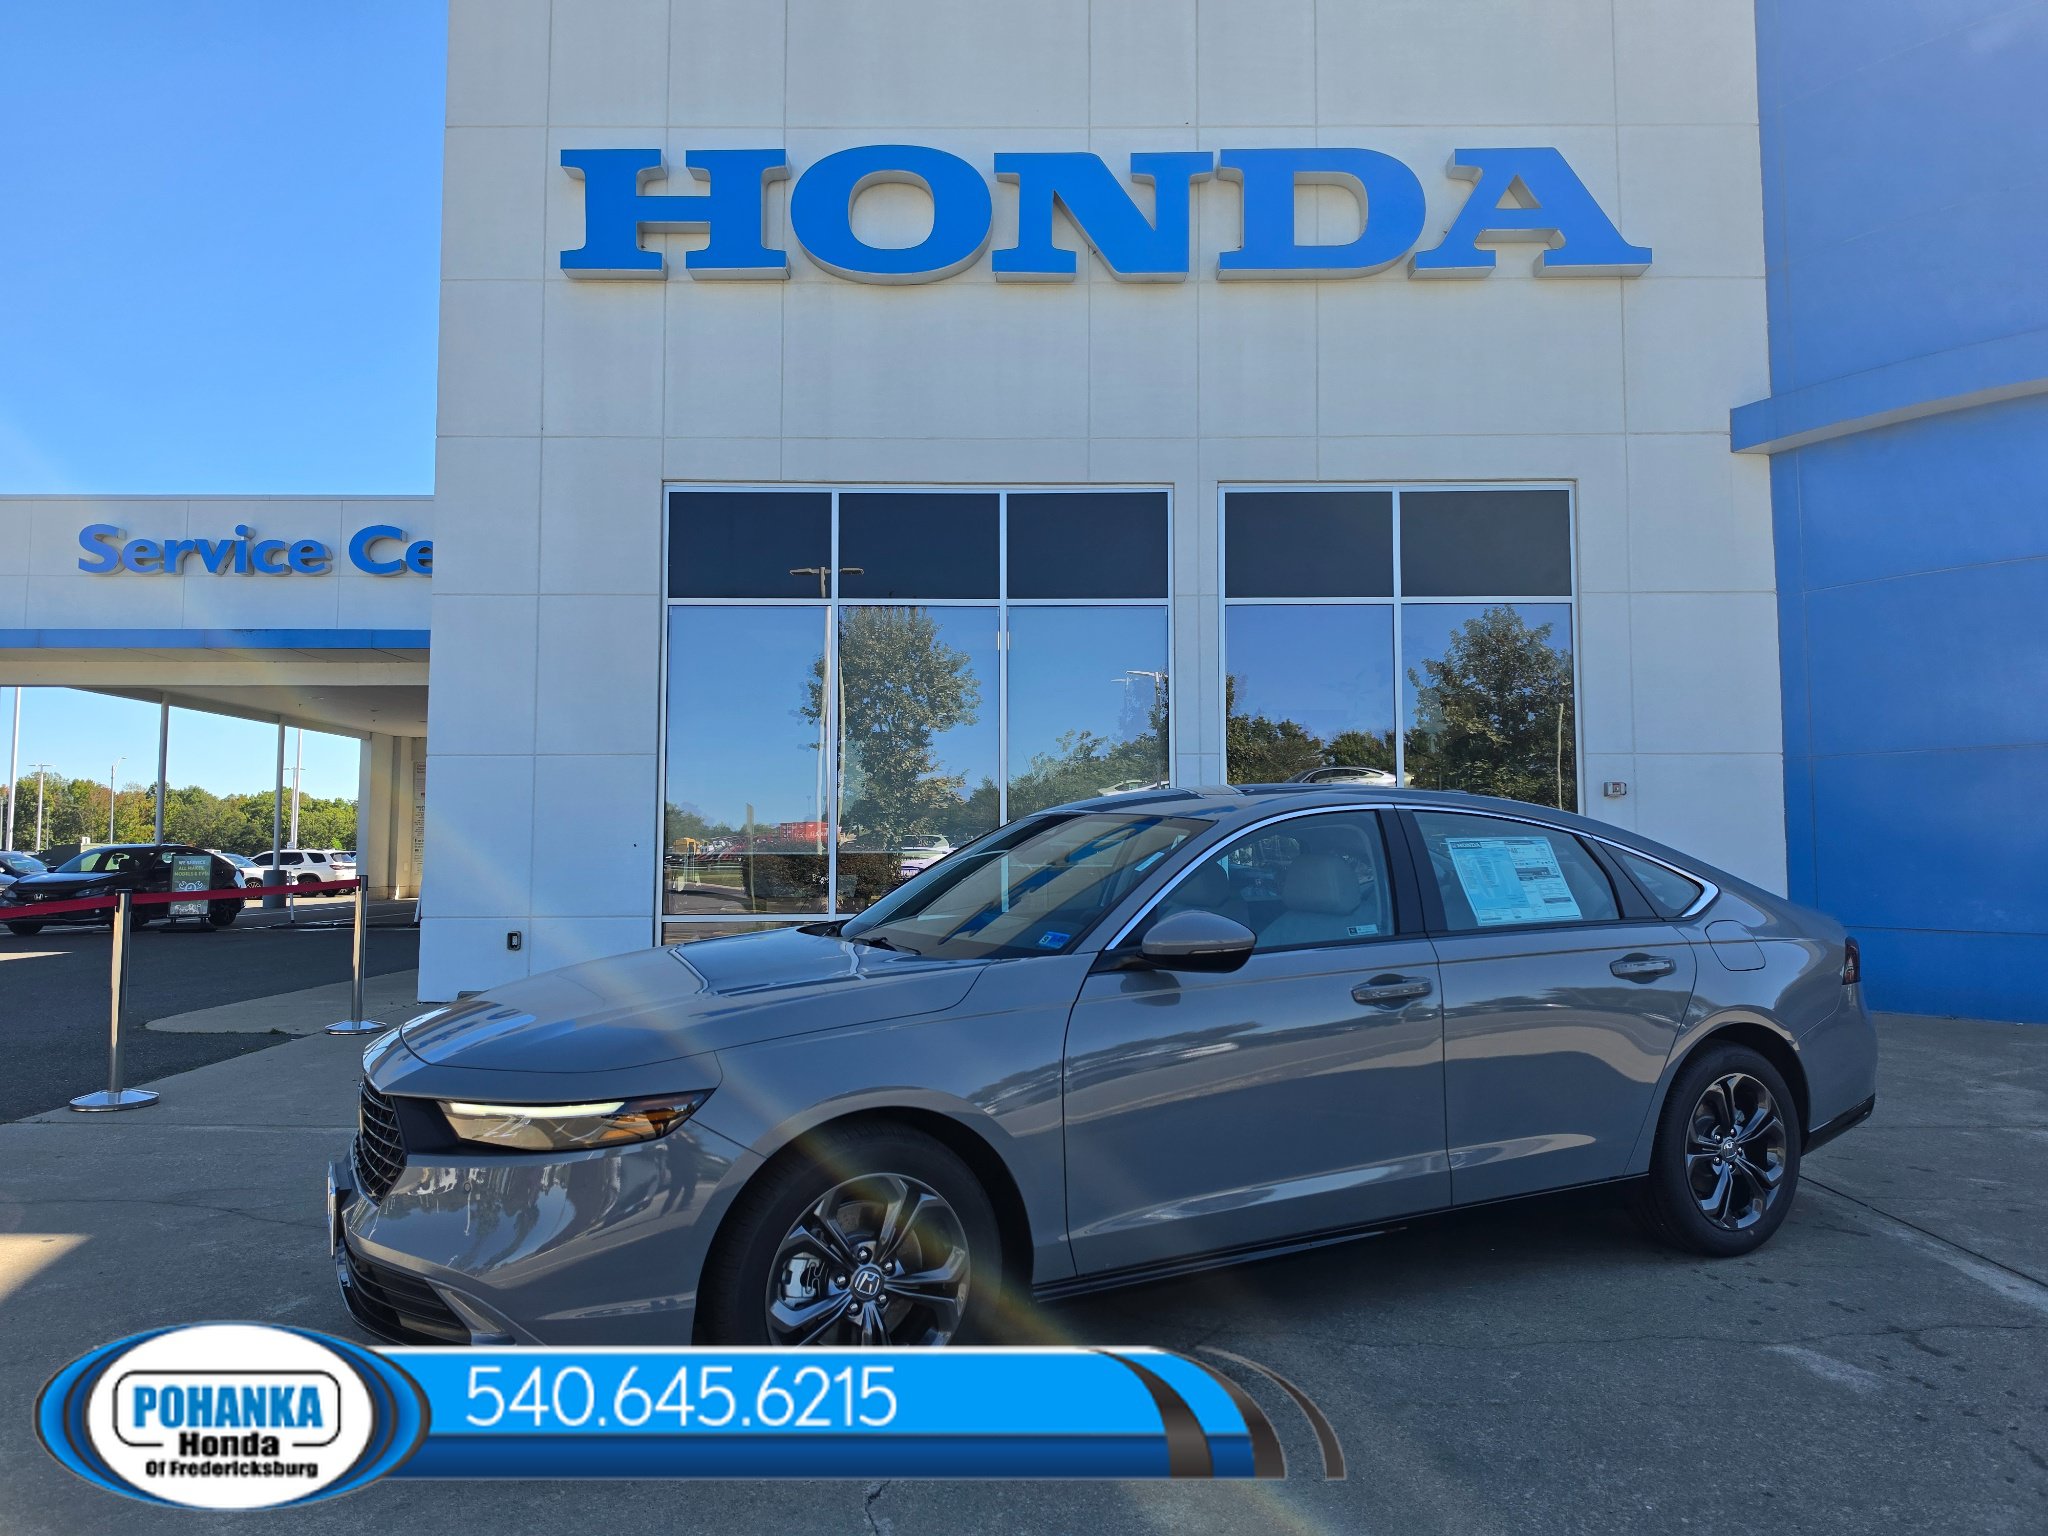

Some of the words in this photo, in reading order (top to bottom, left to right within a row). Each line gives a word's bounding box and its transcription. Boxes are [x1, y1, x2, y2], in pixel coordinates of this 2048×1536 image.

[561, 144, 1652, 282] HONDA
[79, 523, 331, 575] Service
[349, 525, 433, 576] Ce
